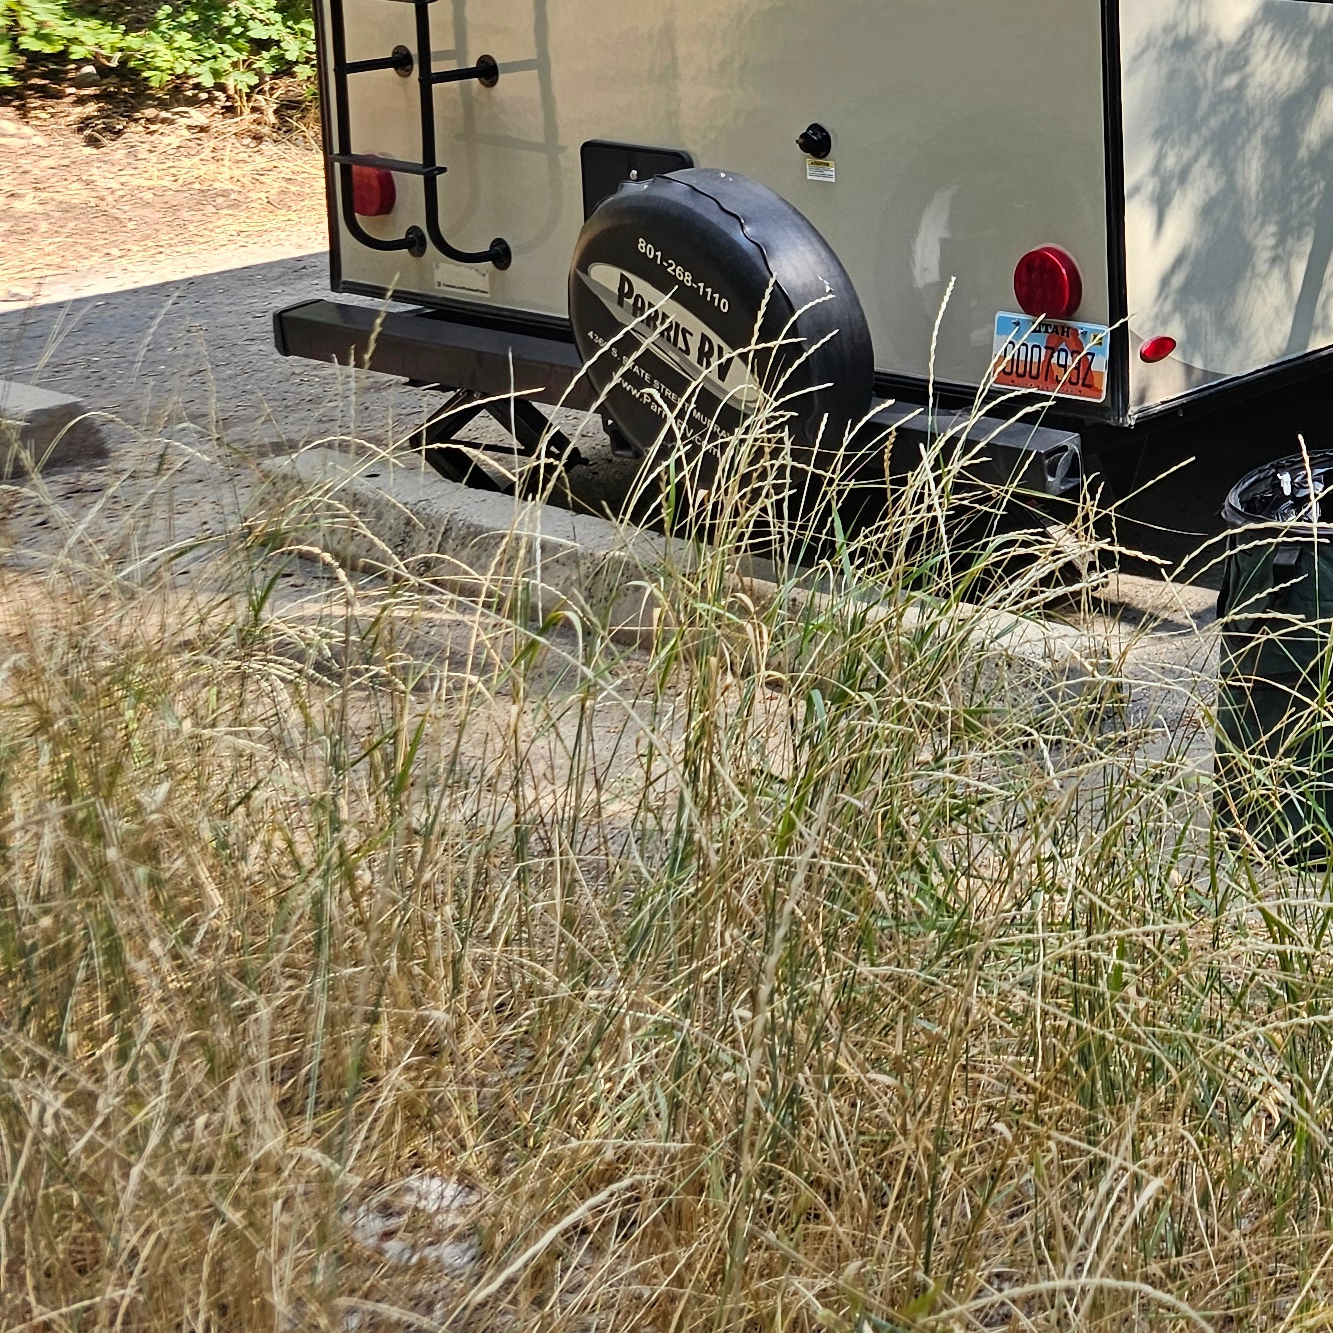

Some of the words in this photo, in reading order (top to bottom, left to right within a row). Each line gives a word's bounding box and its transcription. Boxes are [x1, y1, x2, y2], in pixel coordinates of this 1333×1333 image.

[637, 237, 729, 313] 801-268-1110
[617, 272, 693, 356] PARRIS
[697, 332, 736, 382] RV
